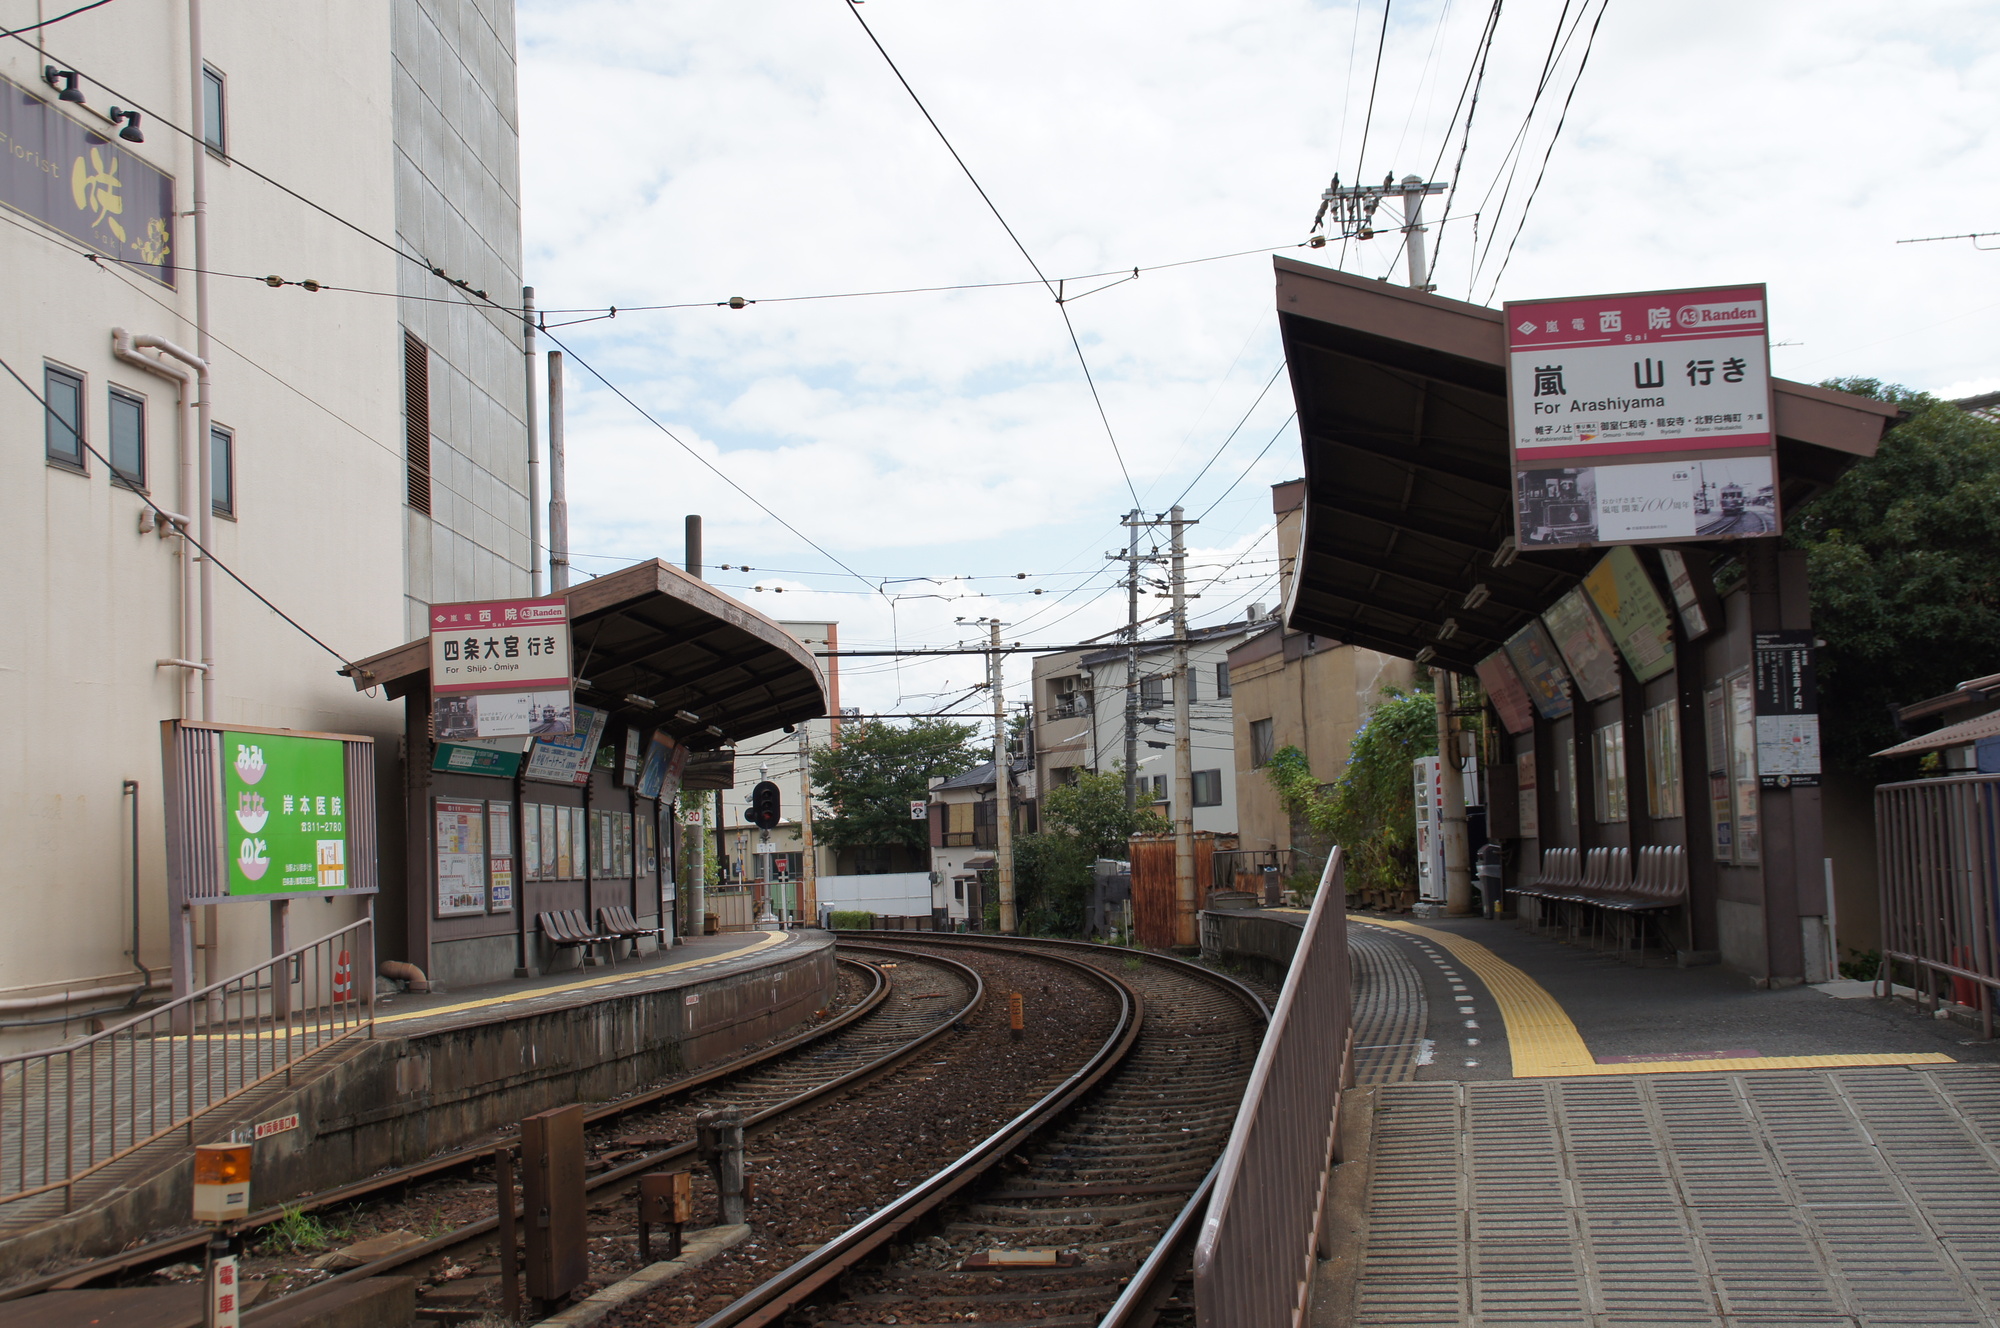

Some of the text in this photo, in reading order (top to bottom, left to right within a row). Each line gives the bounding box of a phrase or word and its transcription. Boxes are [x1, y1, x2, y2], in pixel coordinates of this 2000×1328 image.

[1681, 307, 1757, 323] A3 Randen
[1624, 333, 1648, 342] Sai
[1534, 396, 1665, 415] For Arashiyama
[533, 608, 563, 617] Randen
[445, 666, 460, 674] For
[237, 744, 264, 771] みみ
[238, 791, 266, 818] はな
[283, 794, 342, 816] 岸本医院
[688, 811, 700, 822] 30
[241, 837, 267, 865] のど
[218, 1264, 235, 1328] 電車
